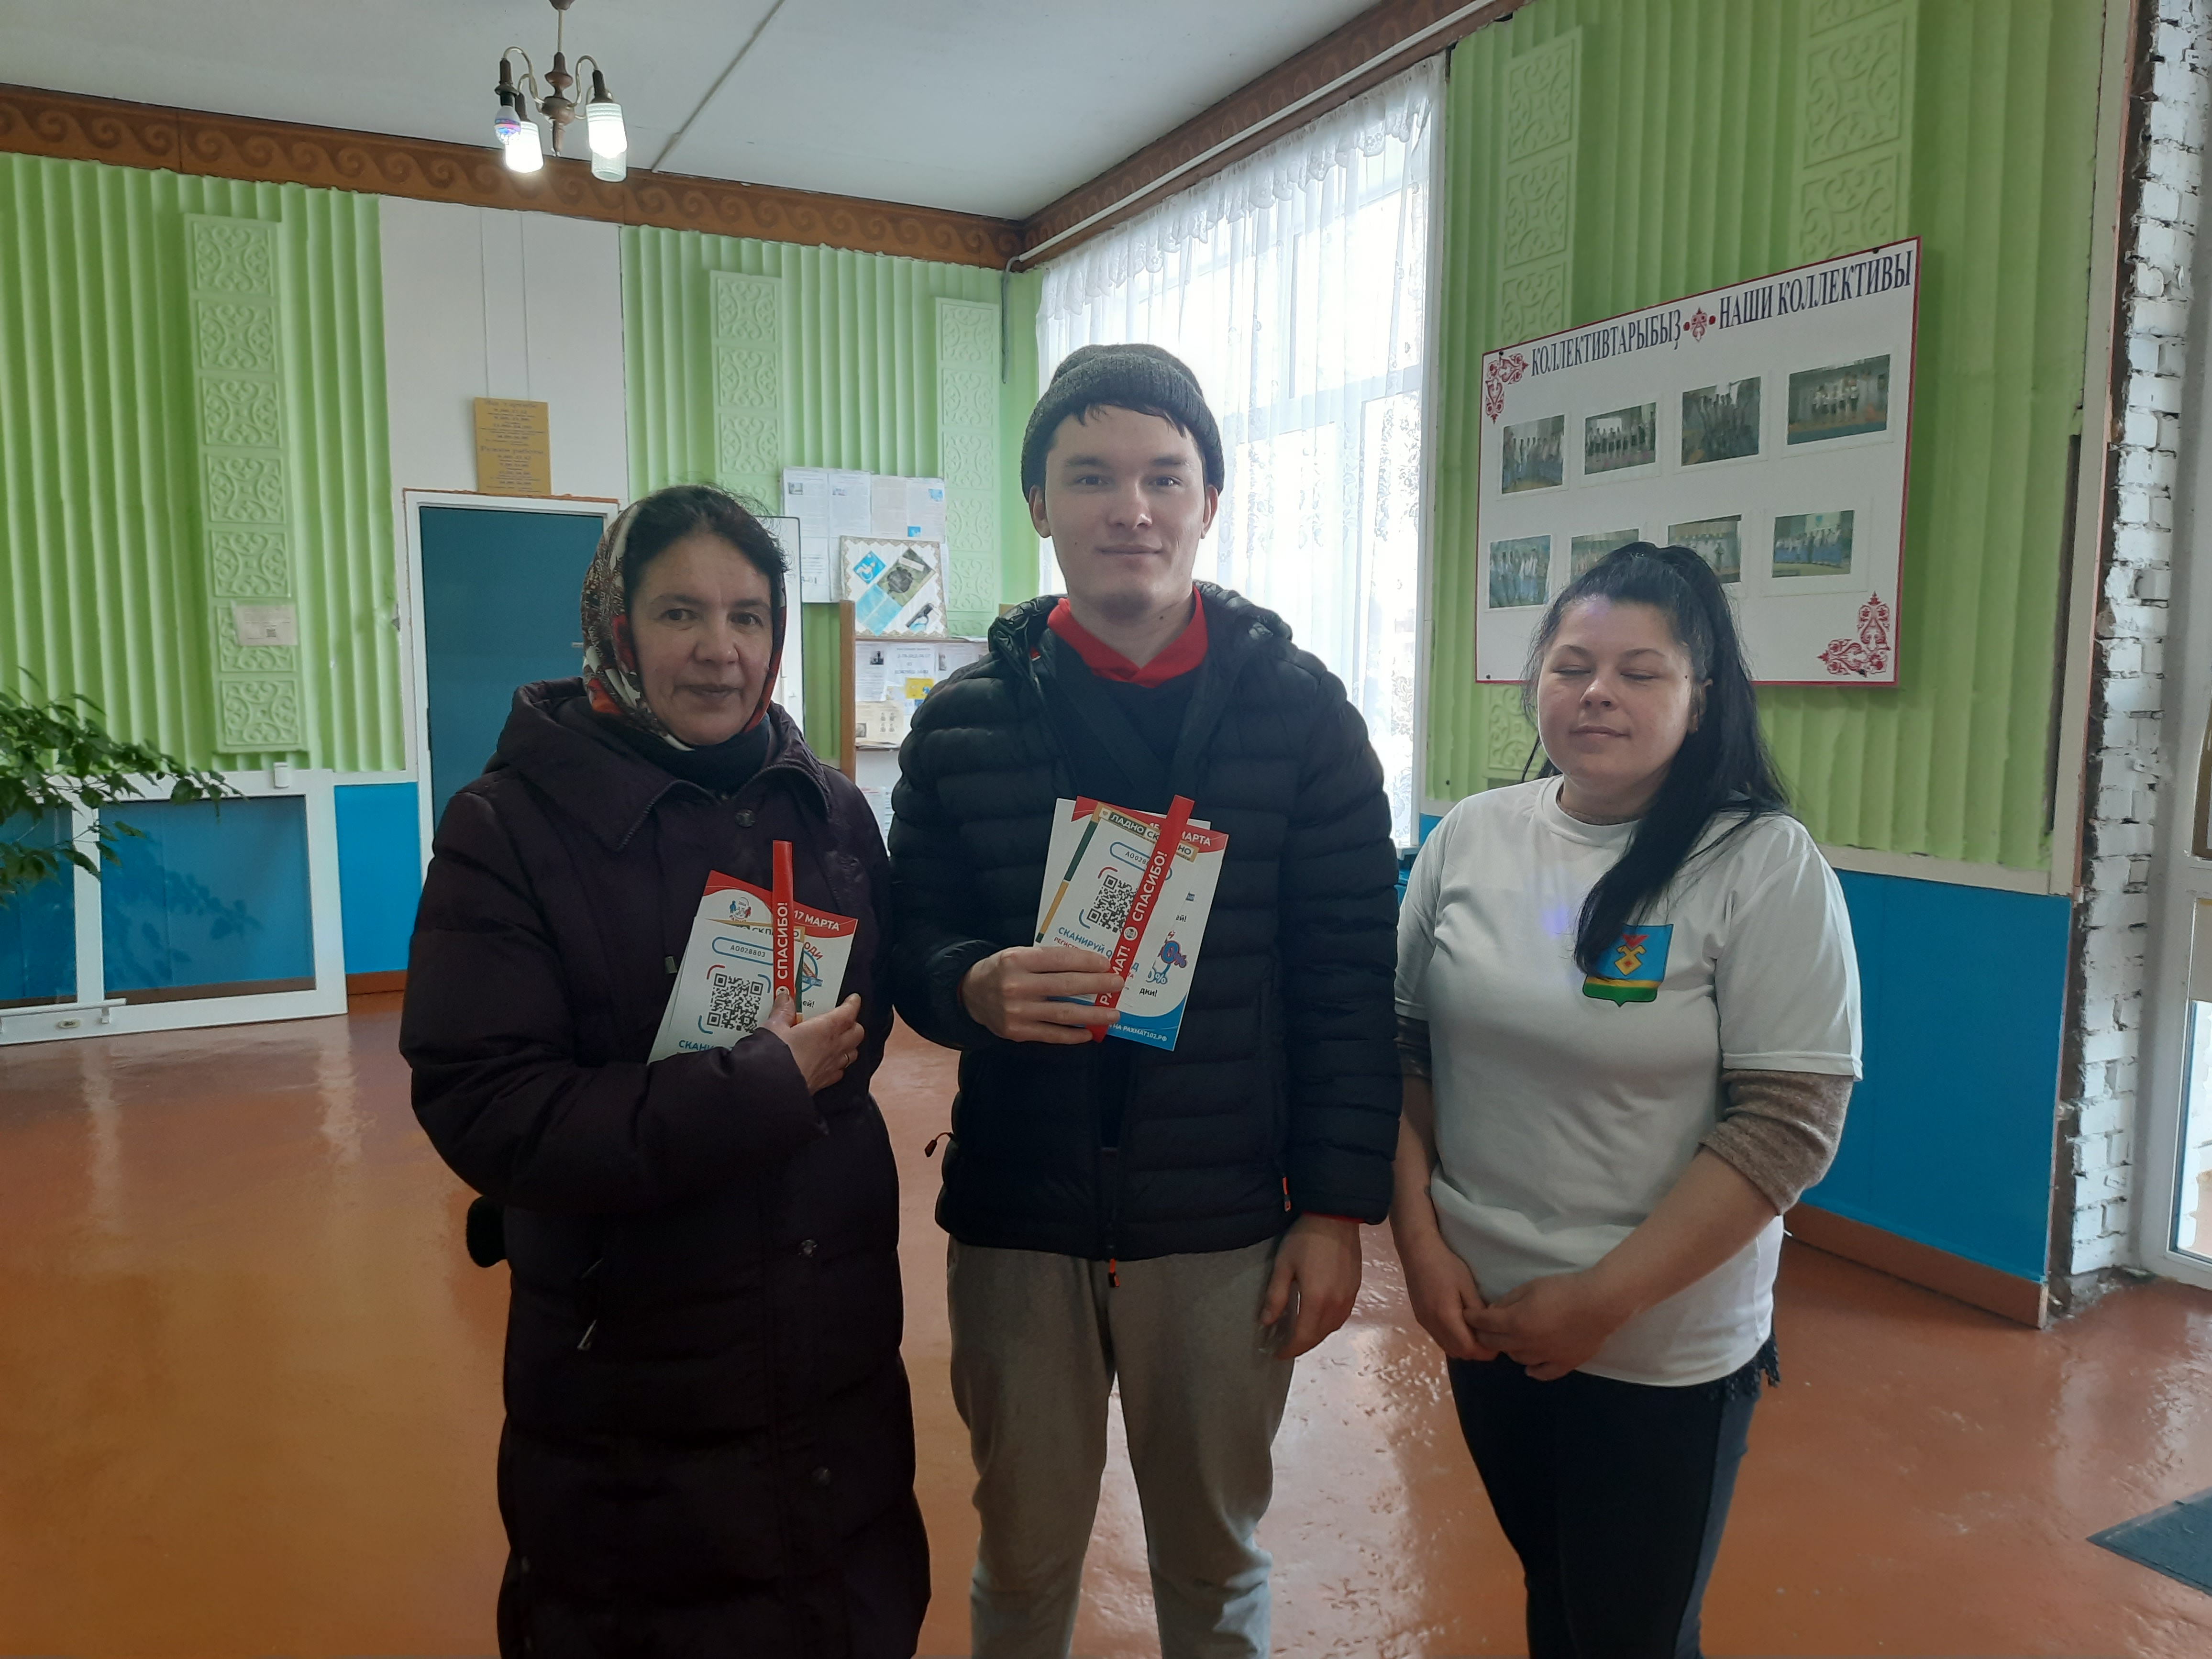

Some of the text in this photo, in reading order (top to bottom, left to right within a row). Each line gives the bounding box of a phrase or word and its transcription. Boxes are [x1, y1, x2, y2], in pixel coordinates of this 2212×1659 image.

[1719, 250, 1913, 330] НАШИ КОЛЛЕКТИВЫ
[1111, 814, 1144, 833] ЛАДНО
[1132, 851, 1167, 922] СПАСИБО!
[777, 902, 788, 979] СПАСИБО!
[805, 915, 840, 931] МАРТА
[1059, 927, 1105, 954] СКАНИРУЙ
